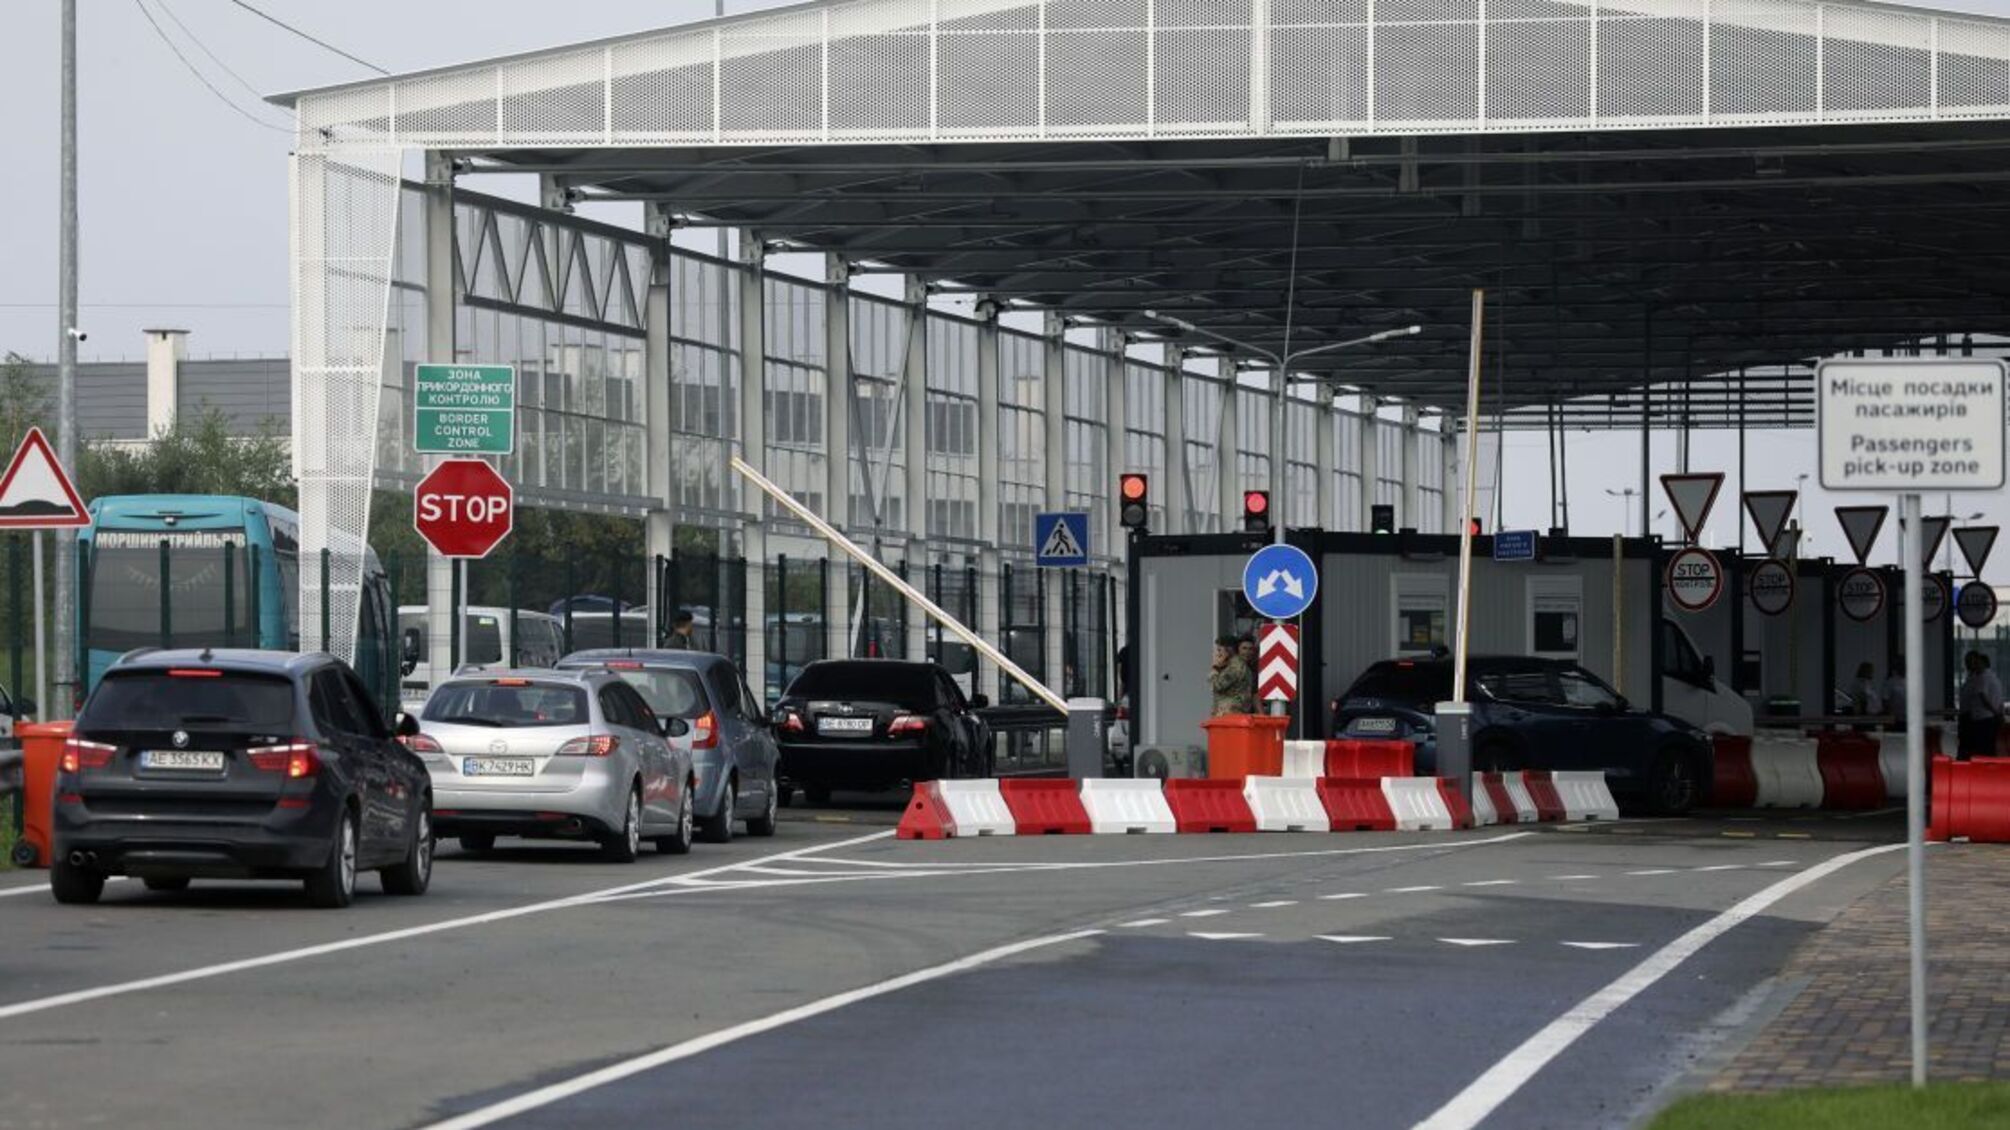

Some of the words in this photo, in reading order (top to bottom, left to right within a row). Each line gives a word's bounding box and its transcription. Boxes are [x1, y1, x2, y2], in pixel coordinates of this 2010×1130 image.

[448, 369, 482, 381] ЗОНА
[417, 381, 511, 393] ПРИКОРДОННОГО
[1831, 379, 1893, 398] Місце
[1904, 382, 1993, 398] посадки
[428, 394, 500, 405] КОНТРОЛЮ
[1855, 400, 1968, 421] пасажирів
[439, 413, 488, 424] BORDER
[434, 425, 493, 437] CONTROL
[447, 437, 480, 448] ZONE
[1851, 434, 1974, 456] Passengers
[1844, 457, 1924, 479] pick-up
[1931, 460, 1980, 474] zone
[420, 493, 507, 523] STOP
[1677, 563, 1710, 576] STOP
[1847, 582, 1875, 593] STOP
